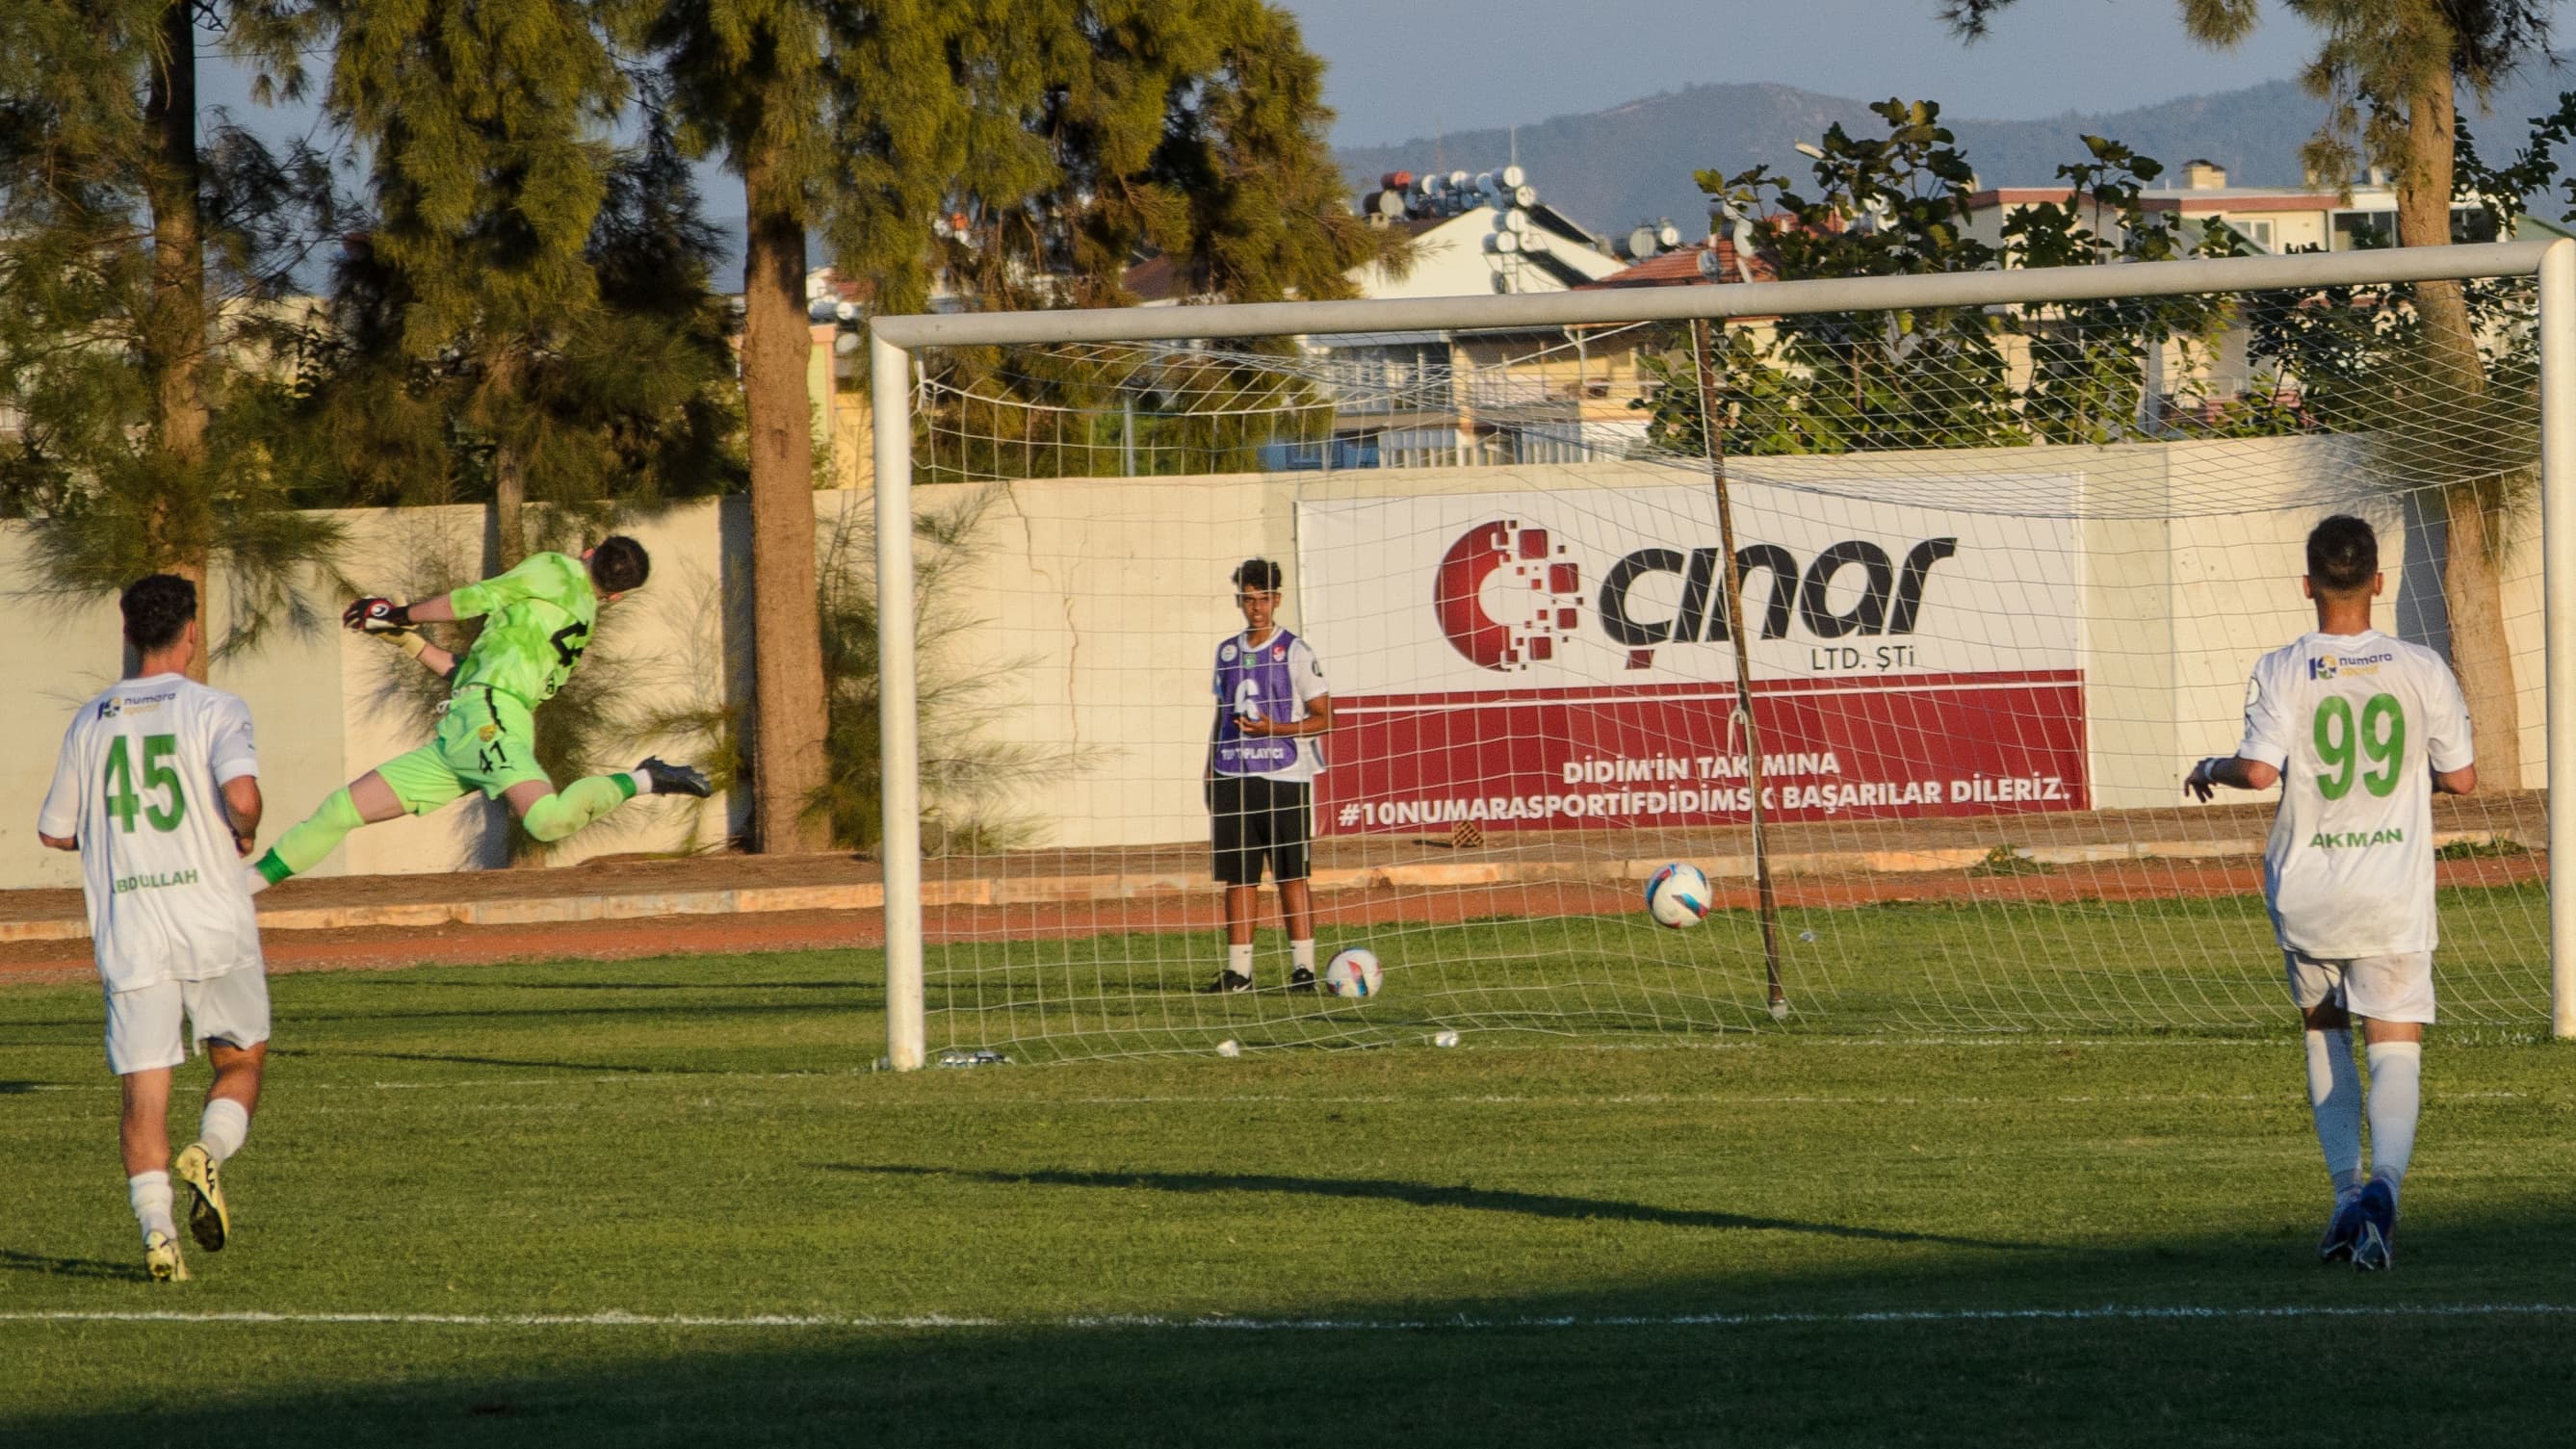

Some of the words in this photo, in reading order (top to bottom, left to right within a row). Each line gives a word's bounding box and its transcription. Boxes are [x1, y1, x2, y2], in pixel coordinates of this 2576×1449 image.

[1811, 646, 1866, 671] LTD.
[2339, 653, 2393, 666] numara
[123, 692, 177, 706] numara
[480, 740, 507, 774] 41
[2313, 692, 2406, 801] 99
[1563, 752, 1688, 784] DİDİM'İN
[1697, 753, 1840, 779] TAKMINA
[104, 734, 186, 834] 45
[1782, 781, 1942, 813] BAŞARILAR
[1950, 770, 2071, 802] DİLERİZ.
[2308, 828, 2404, 848] AKMAN
[113, 869, 198, 893] BDULLAH
